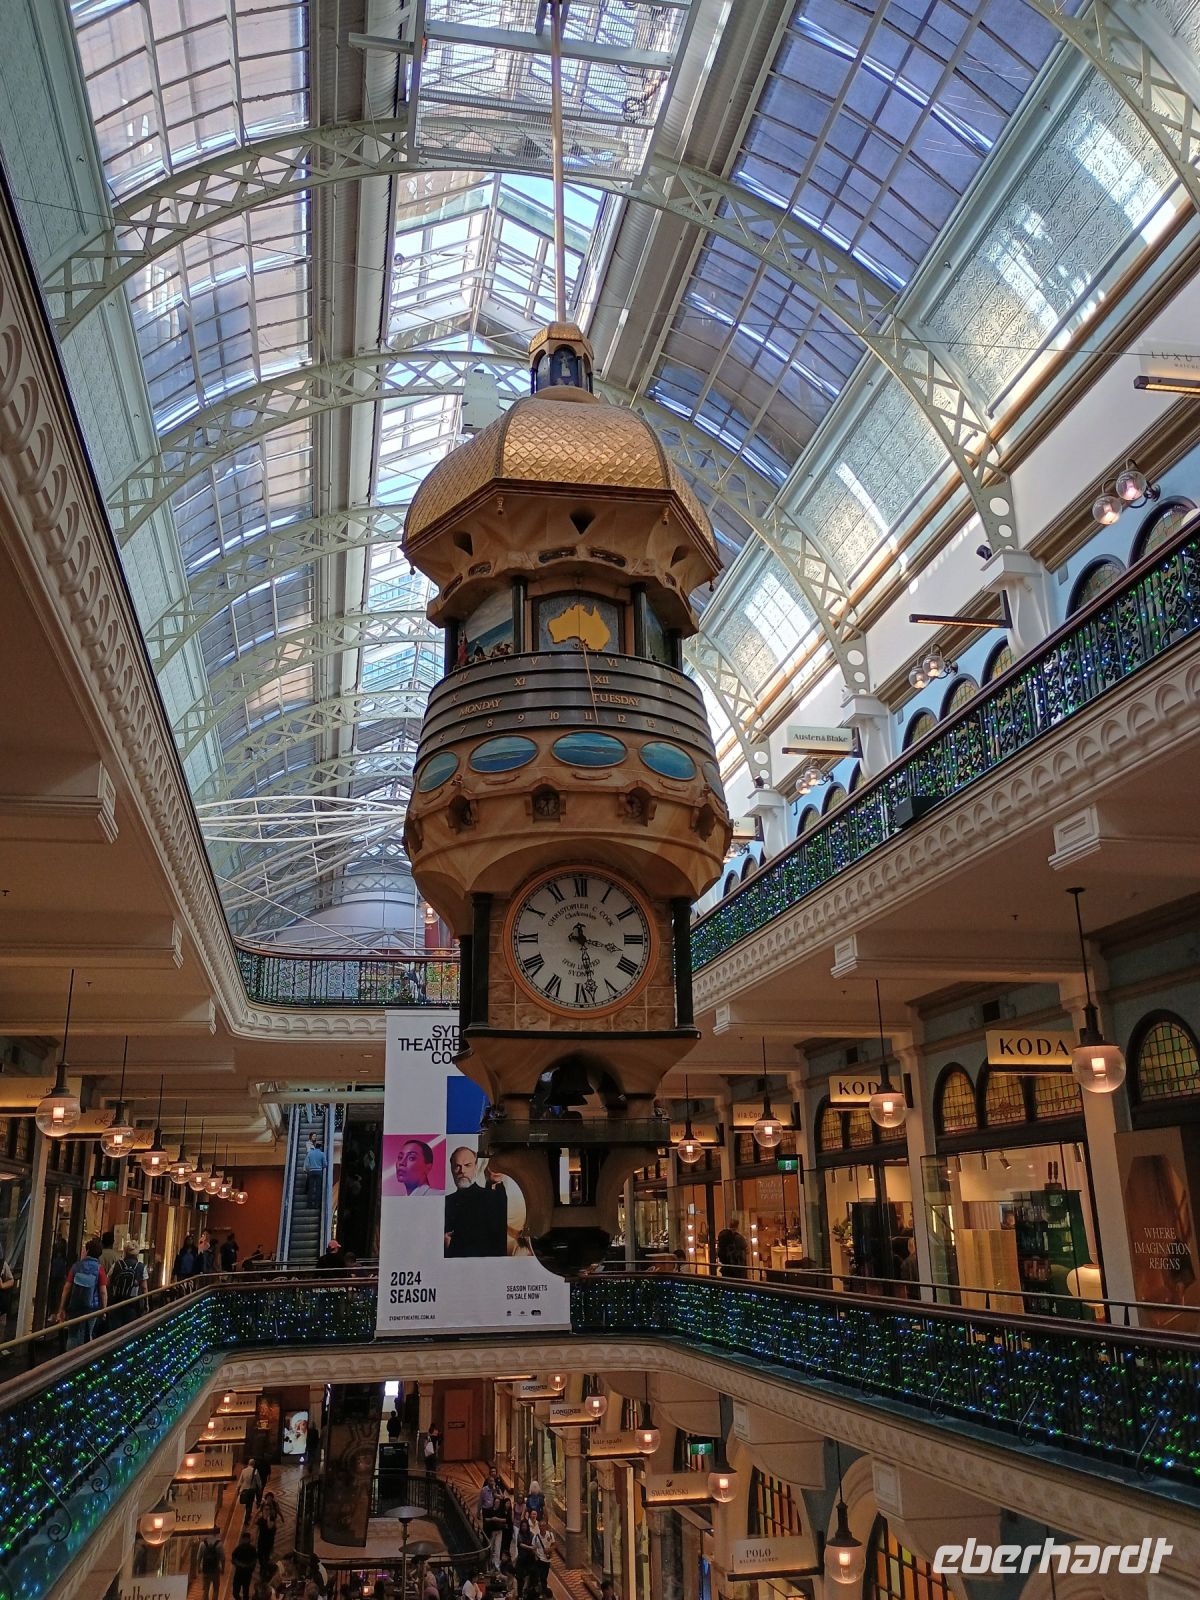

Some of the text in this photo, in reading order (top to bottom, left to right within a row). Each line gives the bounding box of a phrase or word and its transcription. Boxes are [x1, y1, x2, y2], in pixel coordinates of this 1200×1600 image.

[592, 693, 640, 706] TUESDAY
[460, 698, 502, 716] MONDAY
[517, 713, 525, 723] 9
[549, 711, 560, 720] 10
[574, 878, 589, 897] XII
[615, 905, 636, 922] II
[623, 933, 644, 945] III
[398, 1038, 460, 1051] THEATRE
[999, 1037, 1069, 1056] KODA
[838, 1080, 880, 1096] KOD
[1143, 1227, 1177, 1240] WHERE
[1134, 1242, 1191, 1255] IMAGINATION
[1149, 1257, 1181, 1271] REIGNS
[390, 1271, 422, 1286] 2024
[527, 1284, 548, 1292] TICKETS
[390, 1288, 436, 1304] SEASON
[527, 1292, 540, 1300] NOW
[651, 1488, 689, 1496] SWAROVSKI
[746, 1548, 771, 1558] POLO
[121, 1586, 171, 1600] ulberry
